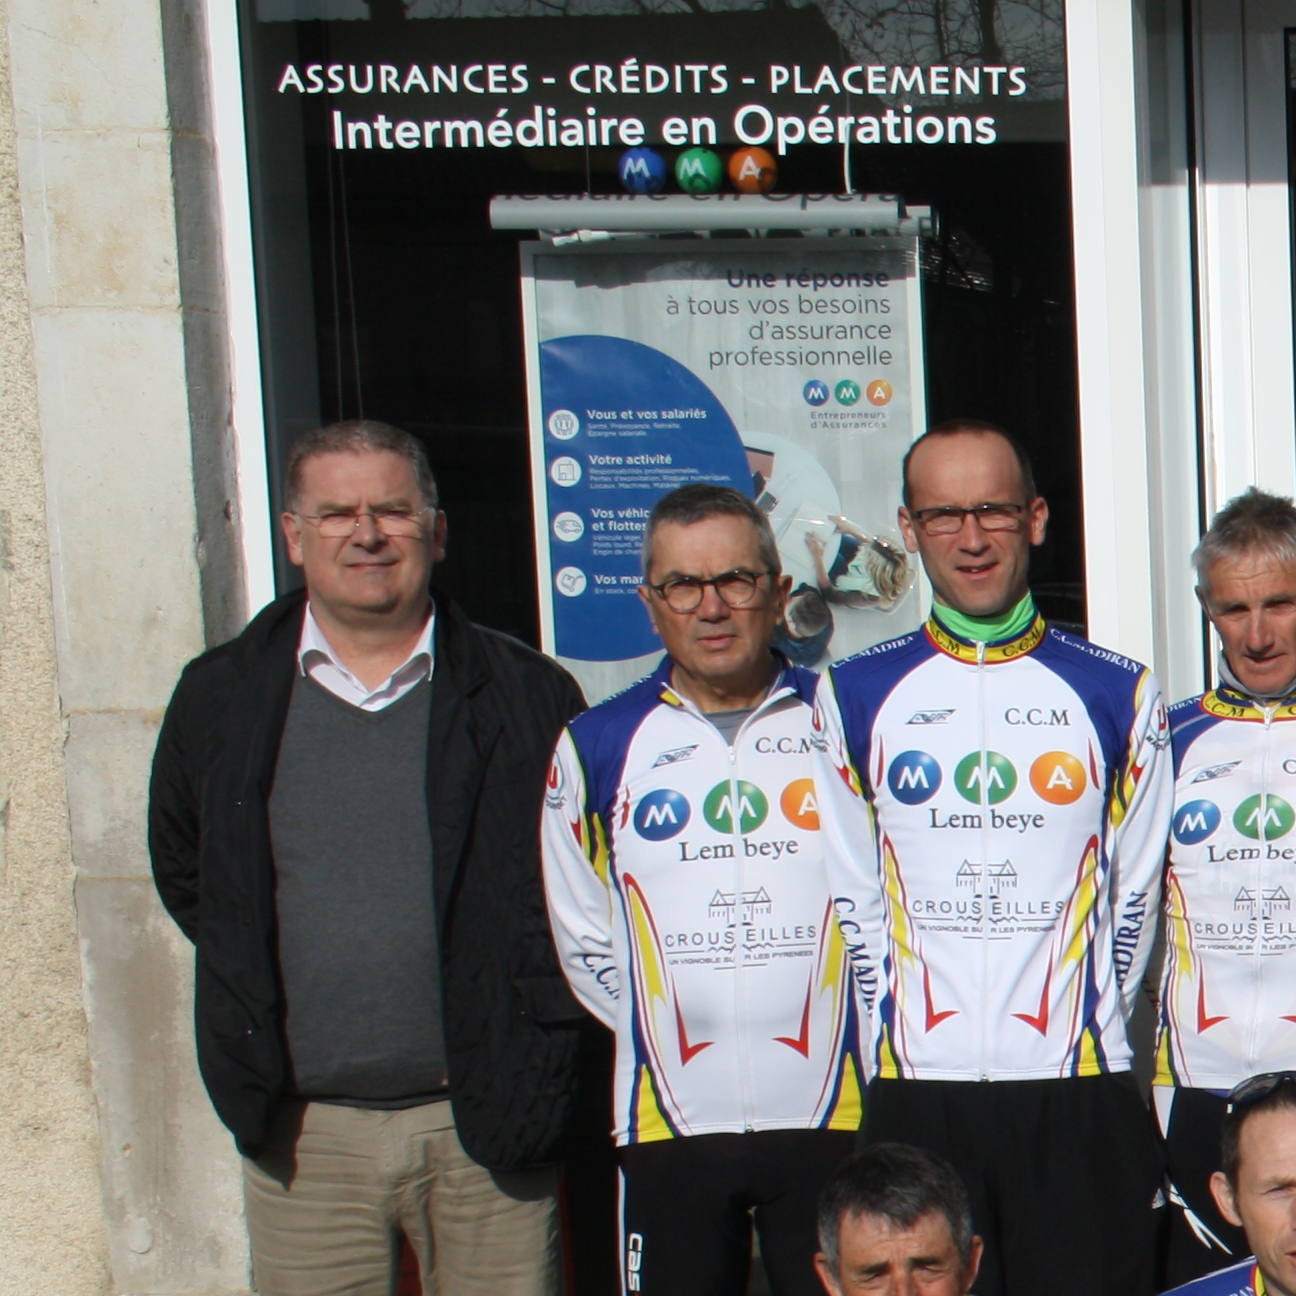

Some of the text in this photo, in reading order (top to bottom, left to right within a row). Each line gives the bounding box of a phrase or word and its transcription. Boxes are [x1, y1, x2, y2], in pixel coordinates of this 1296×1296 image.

[277, 58, 1027, 96] ASSURANCES CRÉDITS PLACEMENTS
[332, 104, 997, 155] Intermédiaire en Opérations
[727, 269, 889, 291] Une réponse
[666, 295, 890, 314] à tous vos besoins
[709, 346, 892, 369] professionnelle
[586, 409, 706, 419] Vous et vos salariés
[811, 411, 886, 421] Entrepreneurs
[589, 454, 672, 465] Votre activité
[591, 508, 650, 518] Vos véhic
[592, 521, 647, 531] et flottes
[594, 575, 617, 584] Vos
[1005, 709, 1070, 726] C.C.M
[929, 808, 1045, 832] Lembeye
[679, 838, 798, 862] Lembeye
[912, 899, 1065, 914] CROUSEILLES
[665, 926, 817, 947] CROUSEILLES
